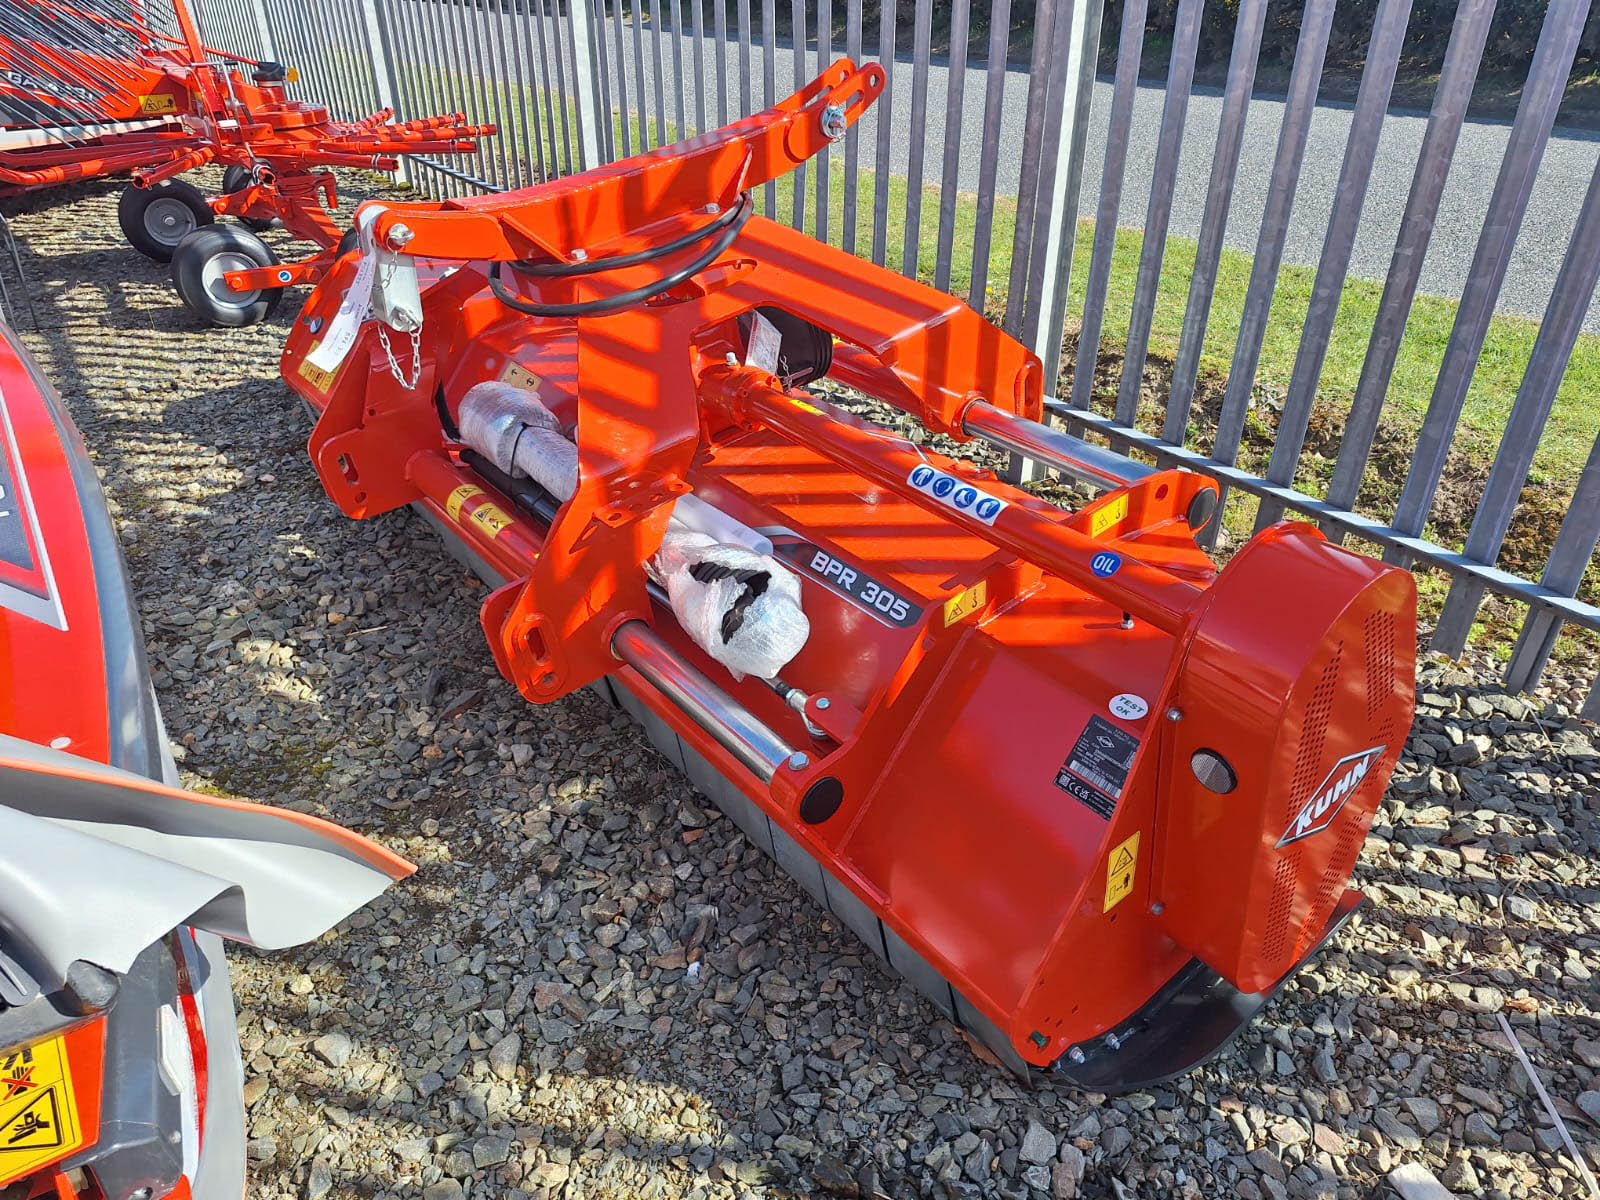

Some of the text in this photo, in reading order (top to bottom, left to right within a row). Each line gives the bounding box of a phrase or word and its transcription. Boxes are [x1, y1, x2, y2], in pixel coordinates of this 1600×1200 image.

[1093, 555, 1115, 574] OIL
[810, 550, 911, 621] BPR 305
[1116, 706, 1130, 715] OK
[1120, 696, 1144, 712] TEST
[1296, 754, 1370, 837] KUHN
